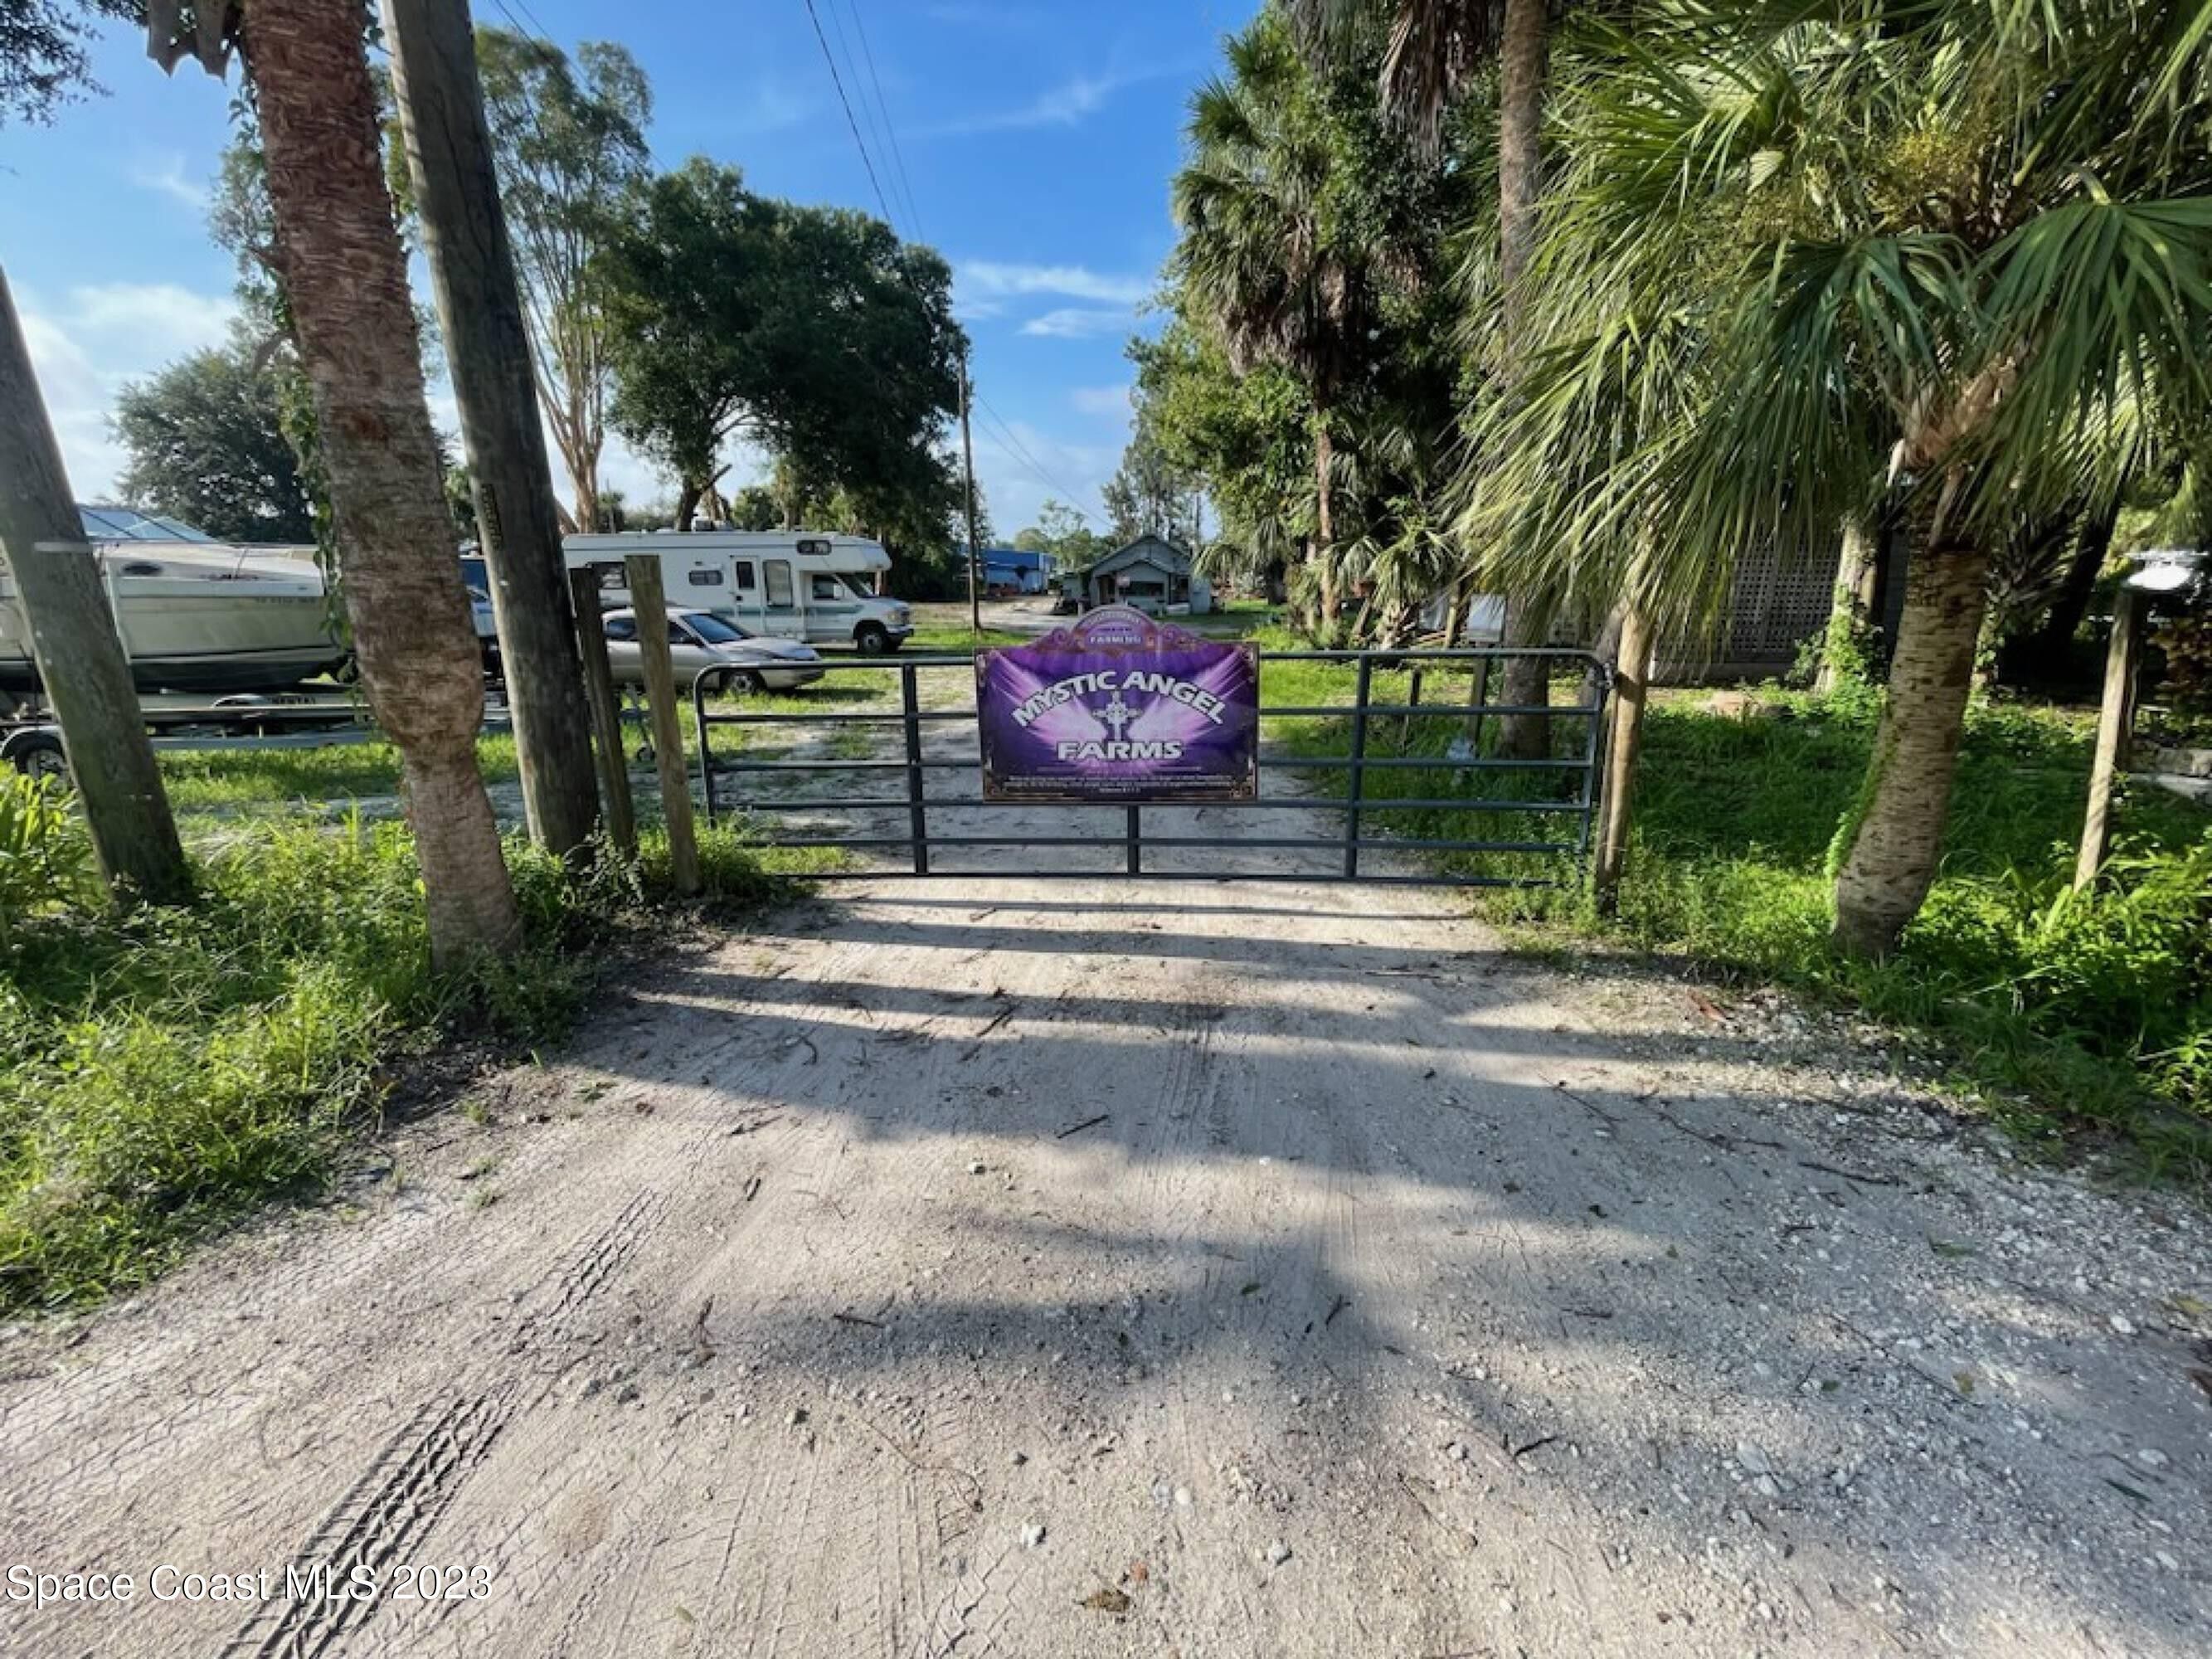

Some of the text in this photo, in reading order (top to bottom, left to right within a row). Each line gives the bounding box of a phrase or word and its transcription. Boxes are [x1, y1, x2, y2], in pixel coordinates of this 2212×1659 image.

[1011, 670, 1227, 727] MYSTIC ANGEL
[1056, 740, 1184, 761] FARMS
